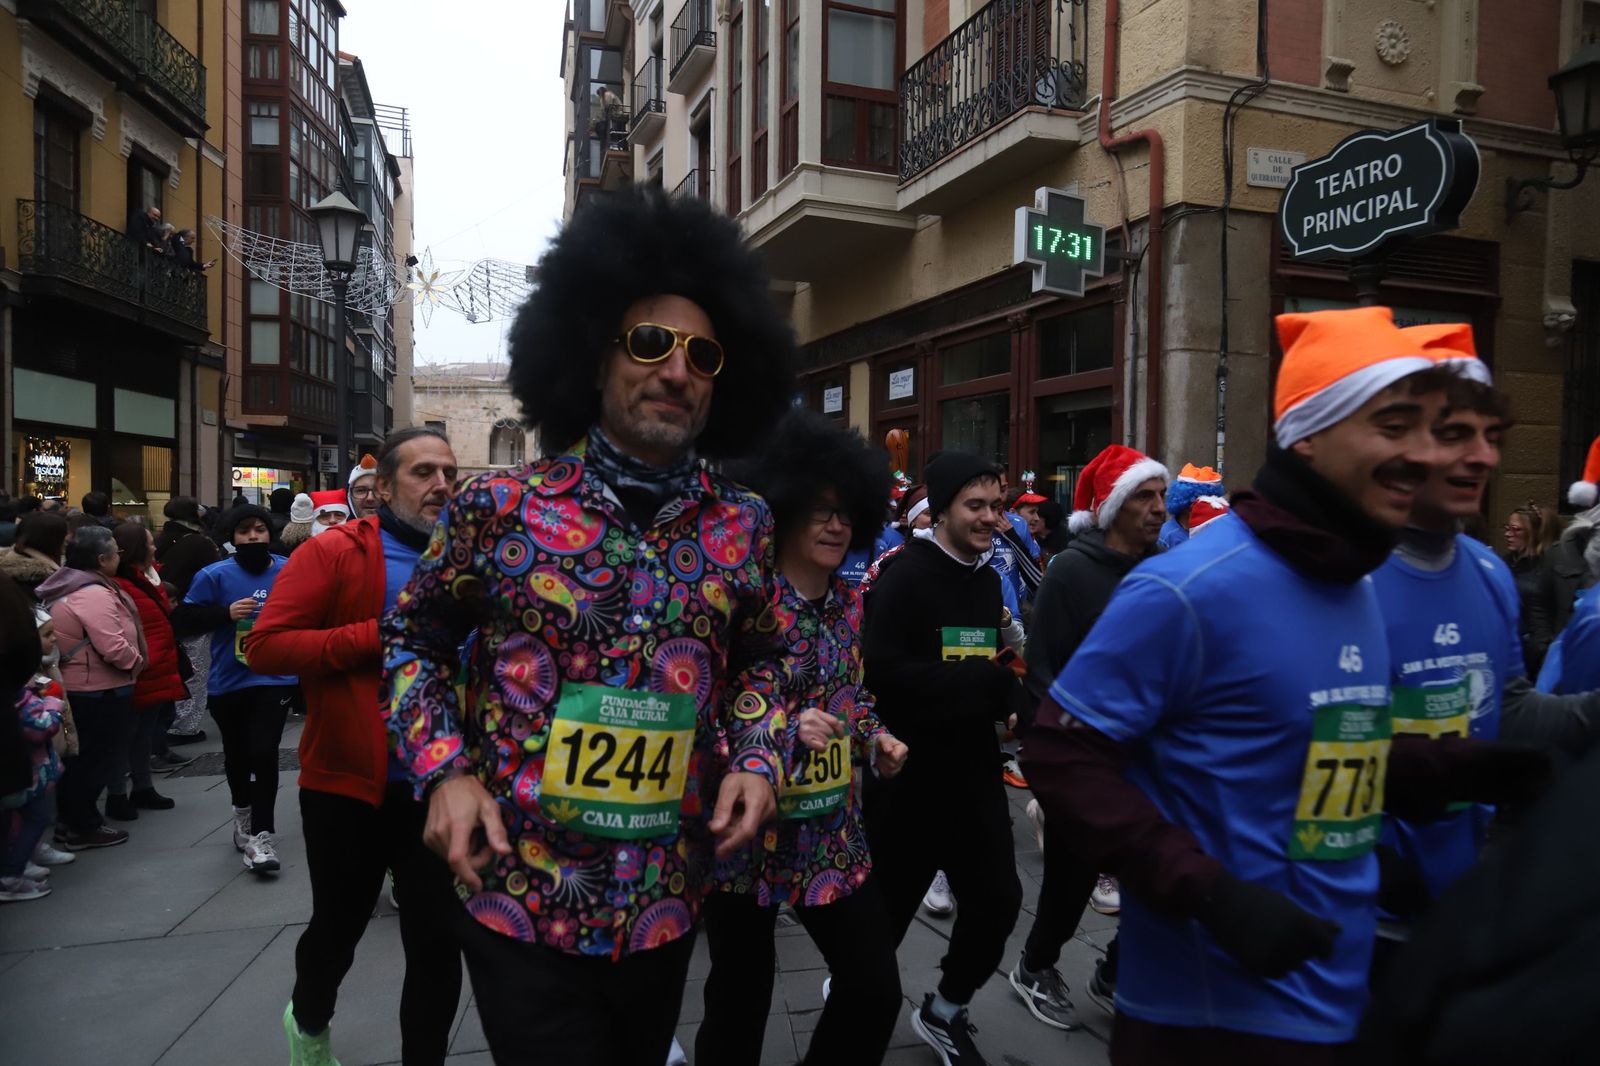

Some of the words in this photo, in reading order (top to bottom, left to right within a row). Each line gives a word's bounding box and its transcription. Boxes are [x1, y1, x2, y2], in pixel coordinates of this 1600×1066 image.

[1268, 155, 1293, 165] CALLE
[1272, 165, 1283, 174] DE
[1314, 153, 1402, 200] TEATRO
[1302, 186, 1419, 238] PRINCIPAL
[1033, 223, 1092, 261] 17:31
[34, 453, 64, 466] MÁXIMA
[854, 561, 866, 570] 46
[253, 589, 268, 599] 46
[1432, 622, 1461, 646] 46
[599, 705, 628, 719] CAJA
[631, 710, 669, 722] RURAL
[561, 727, 675, 792] 1244
[784, 741, 842, 787] 250
[1312, 756, 1378, 818] 773
[799, 798, 825, 811] CAJA
[582, 810, 625, 830] CAJA
[628, 811, 673, 829] RURAL
